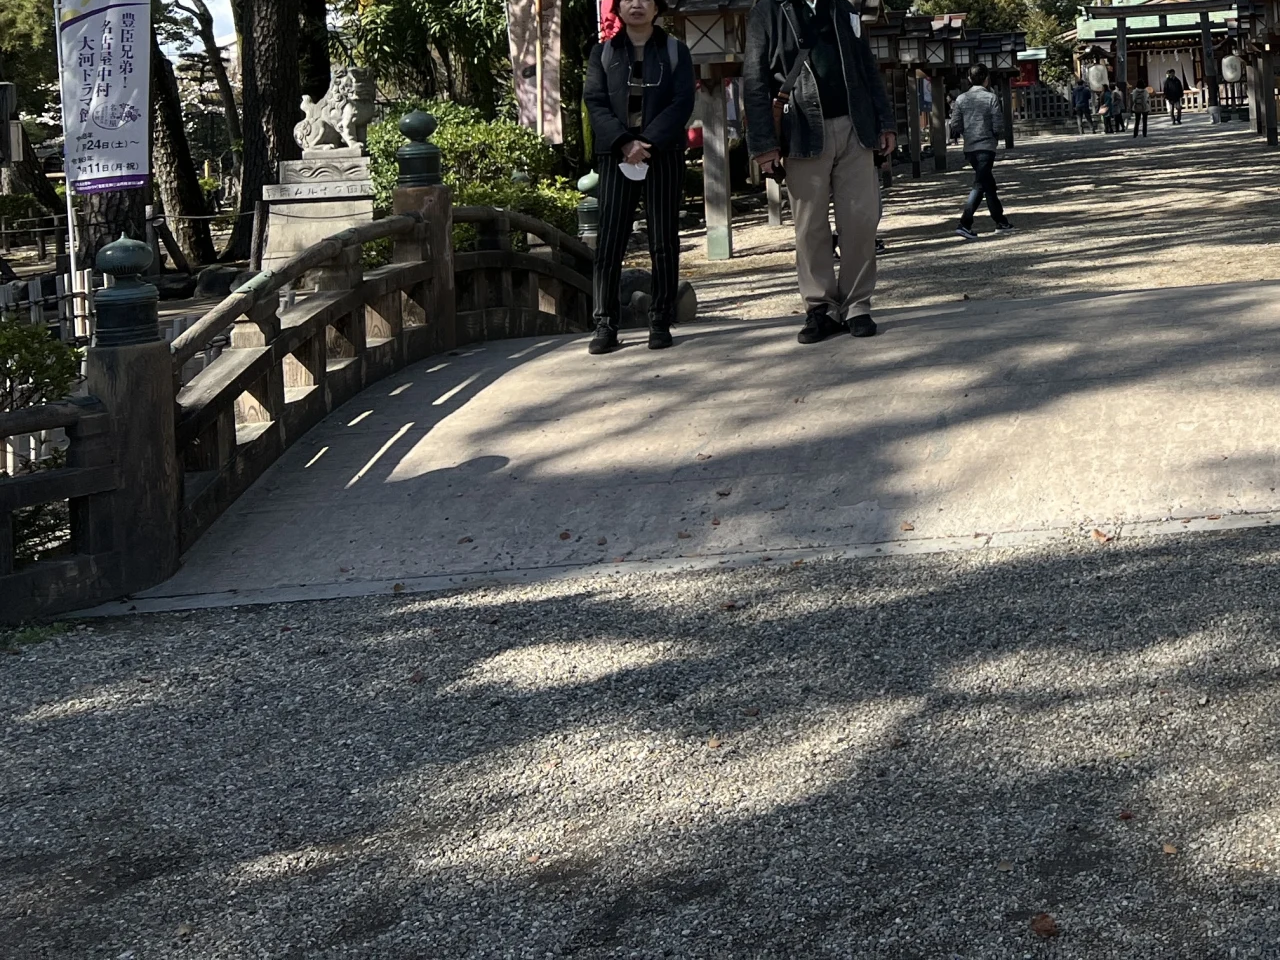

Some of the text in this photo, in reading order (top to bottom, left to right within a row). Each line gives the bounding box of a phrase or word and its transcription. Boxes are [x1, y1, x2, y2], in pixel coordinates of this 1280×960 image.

[96, 19, 114, 98] 名古屋中村
[119, 12, 136, 89] 豊臣兄弟!
